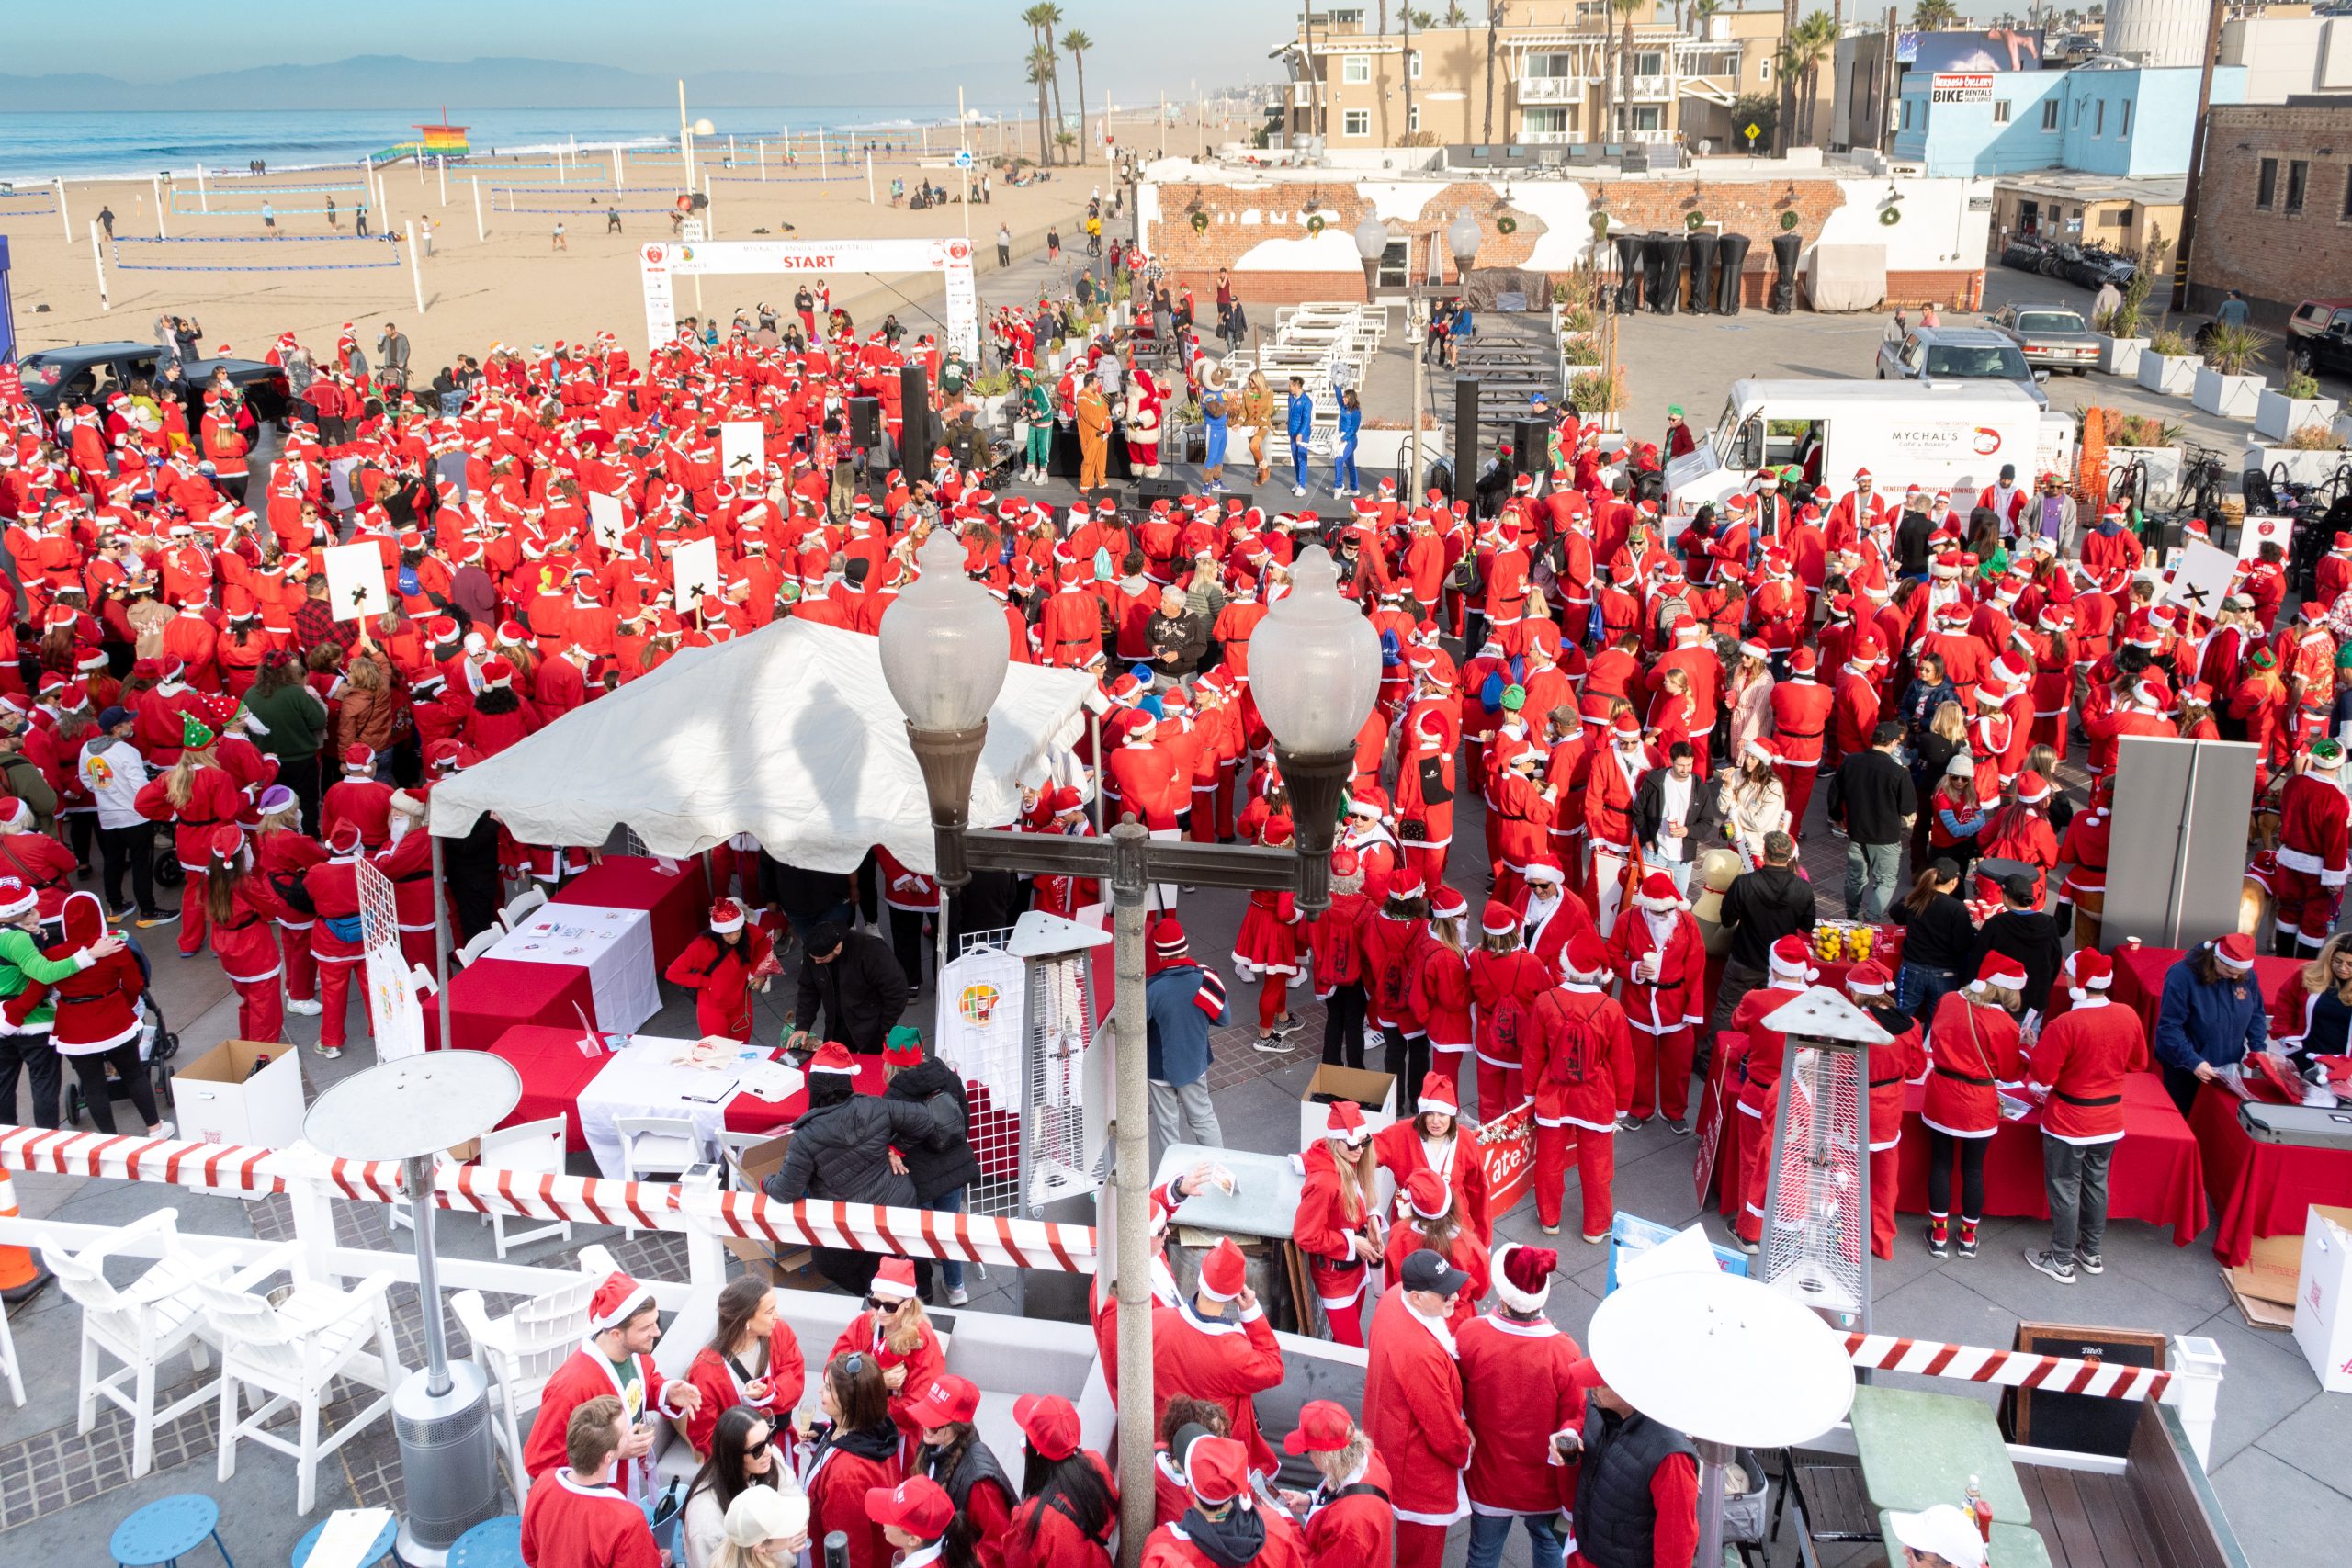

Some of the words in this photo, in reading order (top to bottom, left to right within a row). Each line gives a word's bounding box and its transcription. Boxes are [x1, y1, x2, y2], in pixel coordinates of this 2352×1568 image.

[1933, 90, 1964, 102] BIKE
[784, 255, 835, 267] START
[1892, 432, 1959, 441] MYCHAL'S
[1882, 485, 1909, 493] BENEFITI
[1943, 486, 1973, 494] LEARNING
